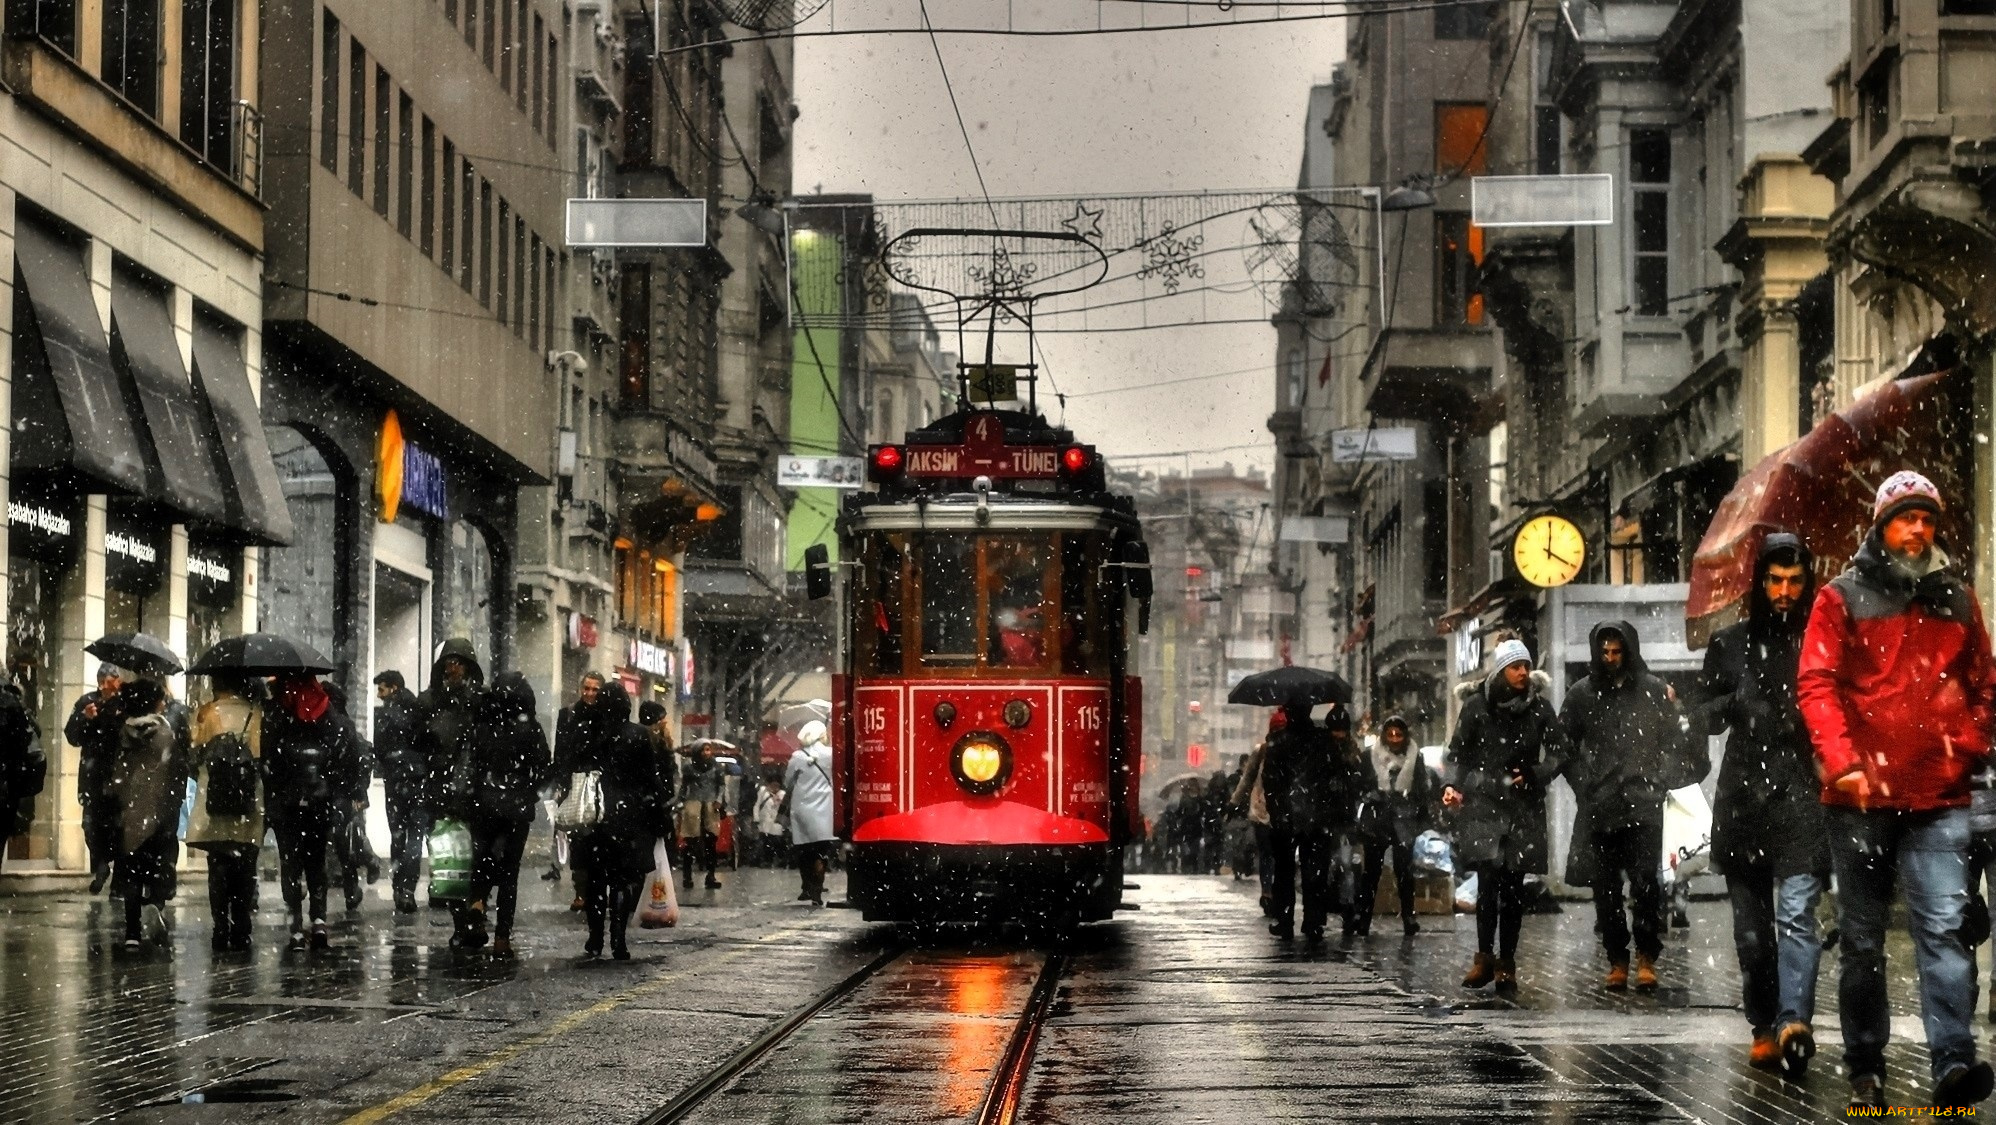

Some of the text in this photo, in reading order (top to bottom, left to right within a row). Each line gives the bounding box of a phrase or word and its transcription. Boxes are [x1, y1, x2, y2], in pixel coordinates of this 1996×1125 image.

[975, 417, 988, 441] 4
[906, 448, 958, 472] TAKSİM
[7, 500, 37, 531] aşabahçe
[863, 707, 885, 730] 115
[1078, 706, 1100, 730] 115
